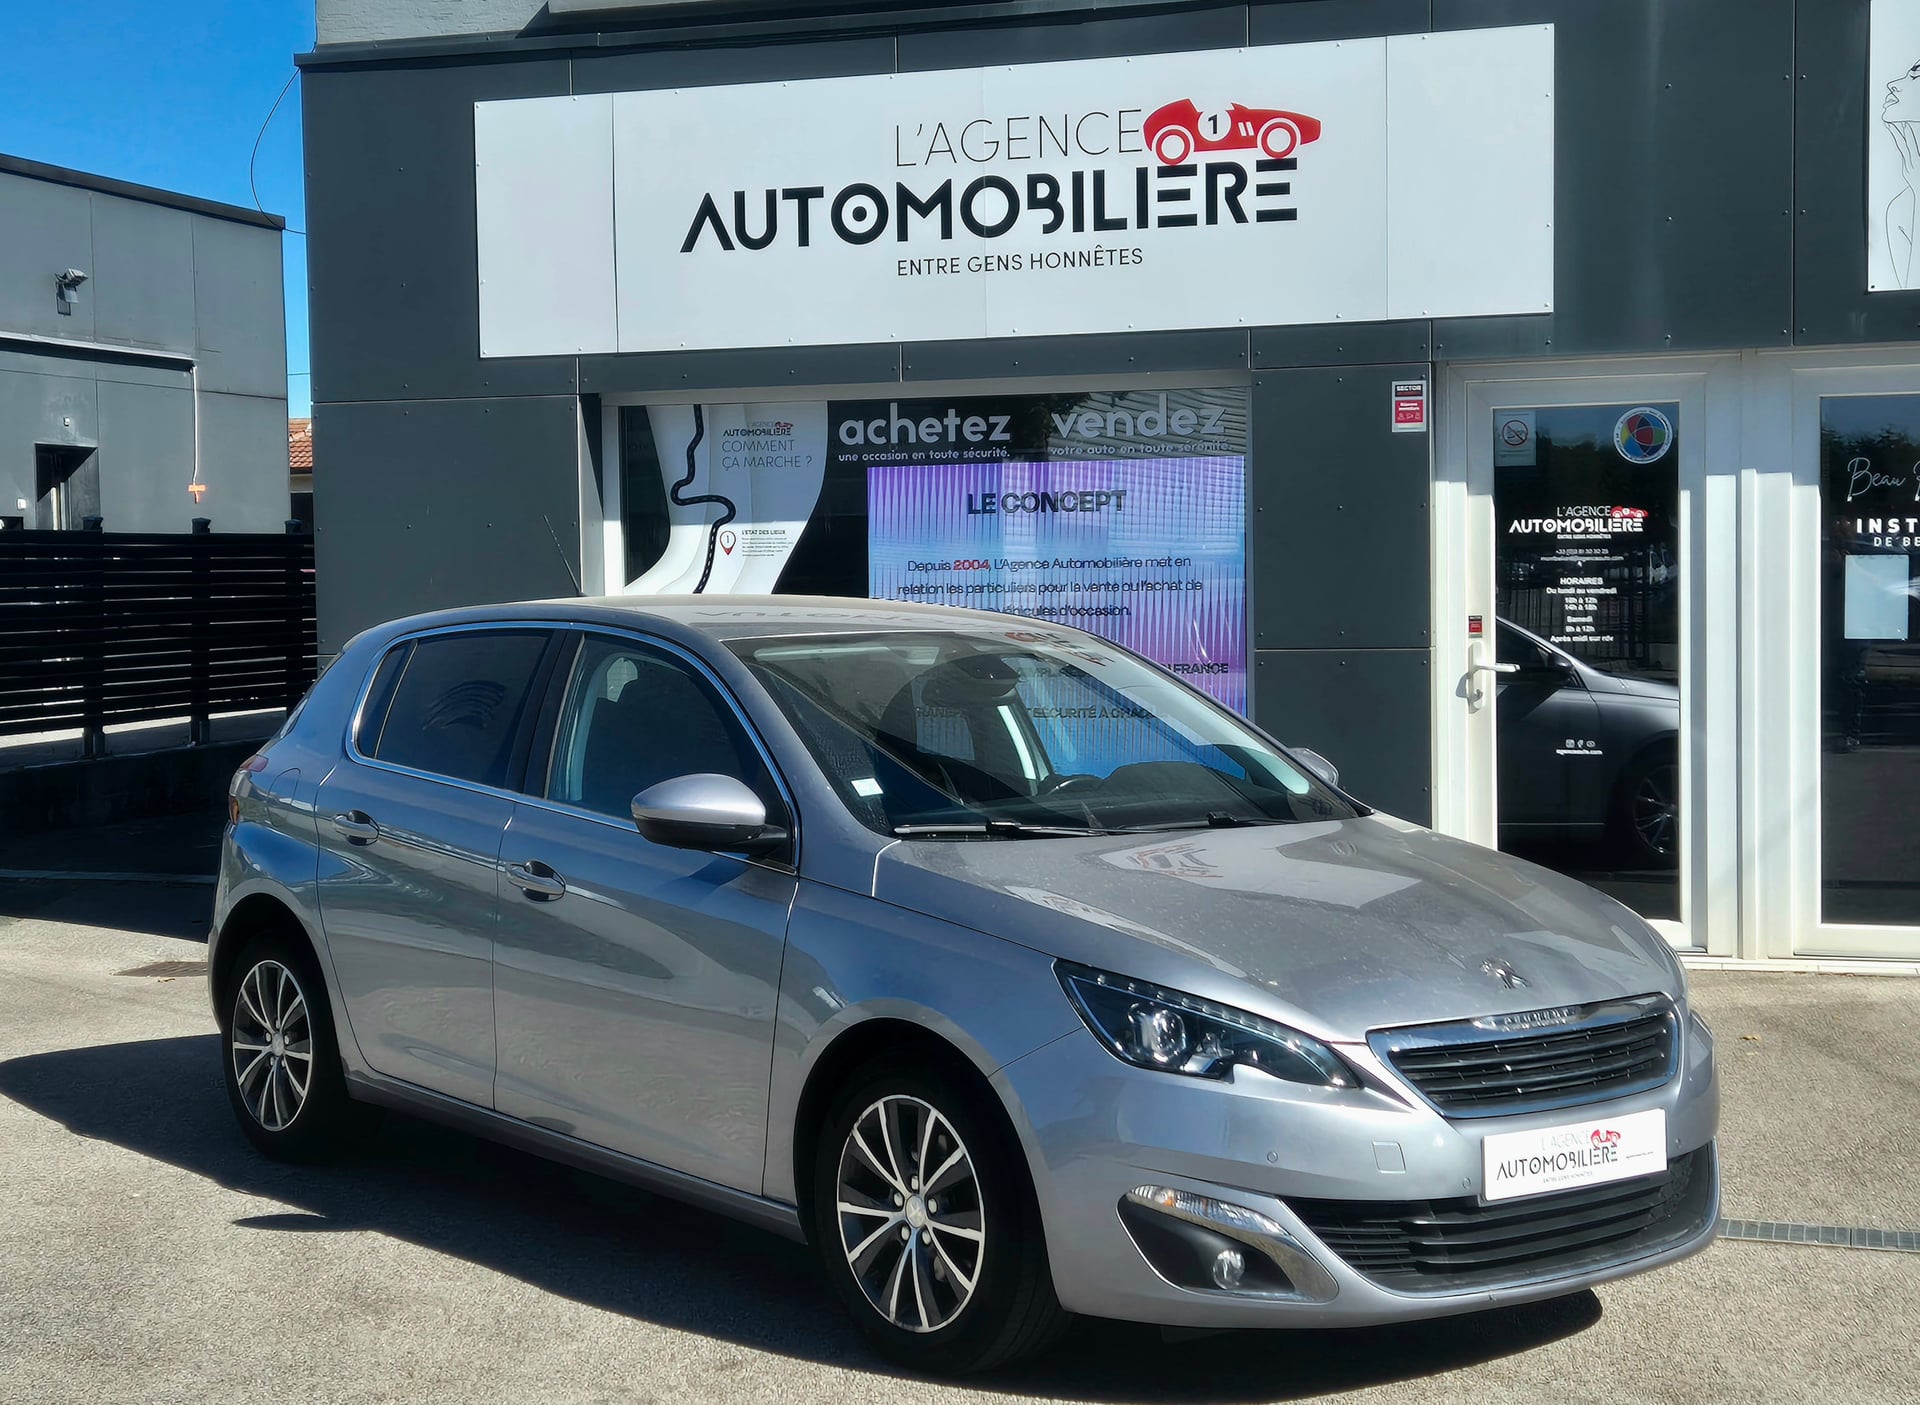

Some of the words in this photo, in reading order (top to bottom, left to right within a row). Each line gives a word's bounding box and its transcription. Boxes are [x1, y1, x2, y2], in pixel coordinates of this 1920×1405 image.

[895, 108, 1143, 168] L'AGENCE
[897, 258, 961, 277] ENTRE
[967, 254, 1023, 274] GENS
[1030, 244, 1144, 270] HONNÊTES
[1050, 392, 1226, 439] vendez
[838, 402, 1012, 446] achetez
[721, 439, 796, 454] COMMENT
[838, 454, 859, 462] une
[862, 451, 909, 461] occasion
[912, 452, 926, 460] en
[929, 449, 960, 459] toute
[962, 446, 1011, 458] sécurité.
[1050, 447, 1083, 456] votre
[1086, 444, 1116, 454] auto
[1120, 445, 1136, 454] en
[1139, 443, 1174, 453] toute
[721, 456, 741, 471] ÇA
[743, 455, 802, 469] MARCHE
[805, 455, 814, 468] ?
[967, 492, 997, 515] LE
[1001, 489, 1127, 514] CONCEPT
[1556, 505, 1612, 517] L'AGENCE
[1873, 536, 1894, 548] DE
[907, 559, 952, 574] Depuis
[953, 558, 992, 572] 2004,
[994, 557, 1050, 573] L'Agence
[1051, 556, 1143, 569] Automobilière
[1145, 555, 1172, 567] met
[1174, 557, 1192, 567] en
[897, 581, 944, 595] relation
[946, 582, 964, 594] les
[965, 581, 1037, 598] particuliers
[1038, 583, 1068, 597] pour
[1070, 581, 1081, 592] la
[1083, 582, 1120, 592] vente
[1121, 581, 1139, 592] ou
[1140, 579, 1183, 591] l'achat
[1185, 578, 1204, 590] de
[1559, 577, 1604, 585] HORAIRES
[1059, 604, 1132, 616] d'occasion.
[1173, 663, 1229, 675] FRANCE
